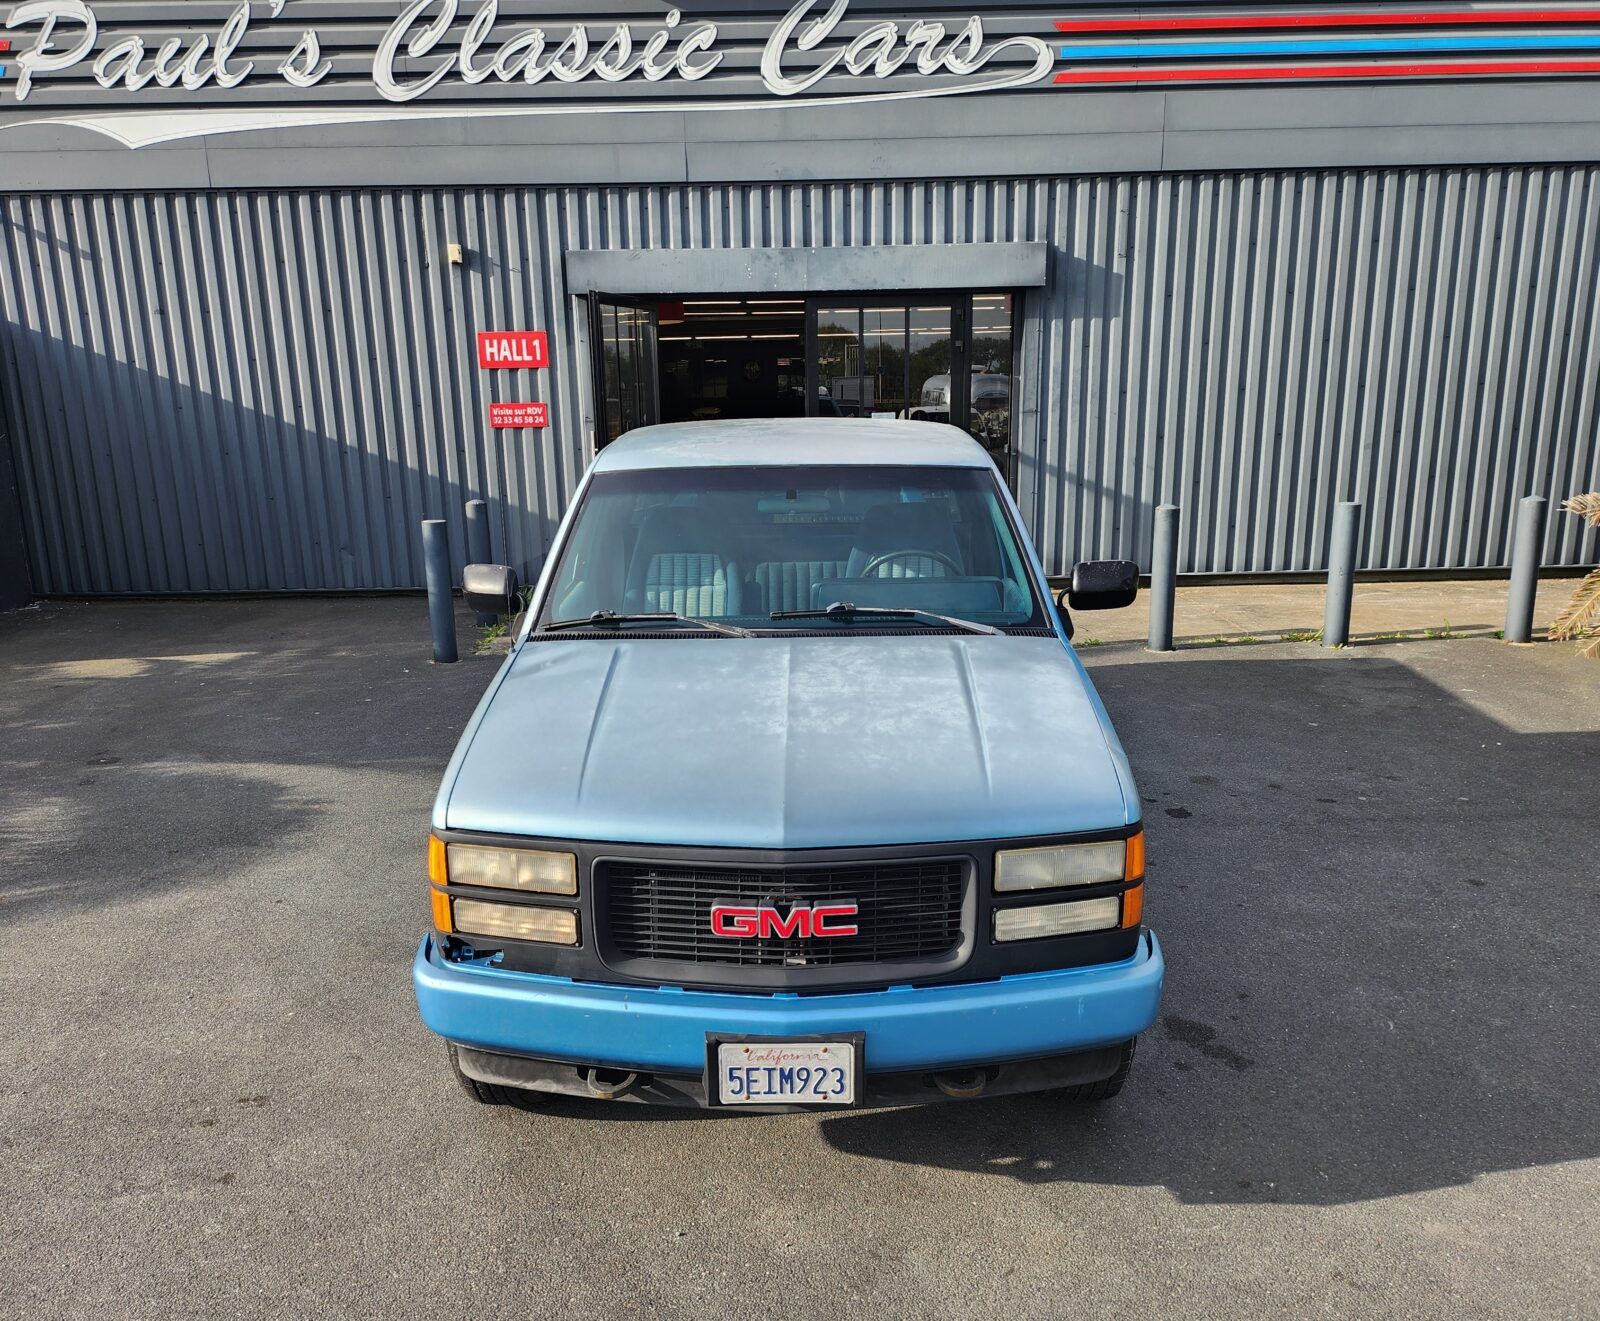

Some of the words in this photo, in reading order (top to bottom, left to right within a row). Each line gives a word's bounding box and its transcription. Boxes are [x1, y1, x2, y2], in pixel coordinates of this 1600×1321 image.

[6, 0, 333, 101] Paul's
[372, 0, 724, 102] Classic
[760, 0, 1055, 96] Cars
[493, 407, 513, 416] Visite
[514, 408, 526, 416] sur
[527, 406, 543, 415] RDV
[503, 416, 513, 424] 33
[513, 416, 523, 424] 45
[524, 416, 534, 424] 58
[534, 415, 544, 423] 24
[711, 903, 858, 938] GMC
[747, 1049, 828, 1065] California
[728, 1067, 845, 1095] 5EIM923
